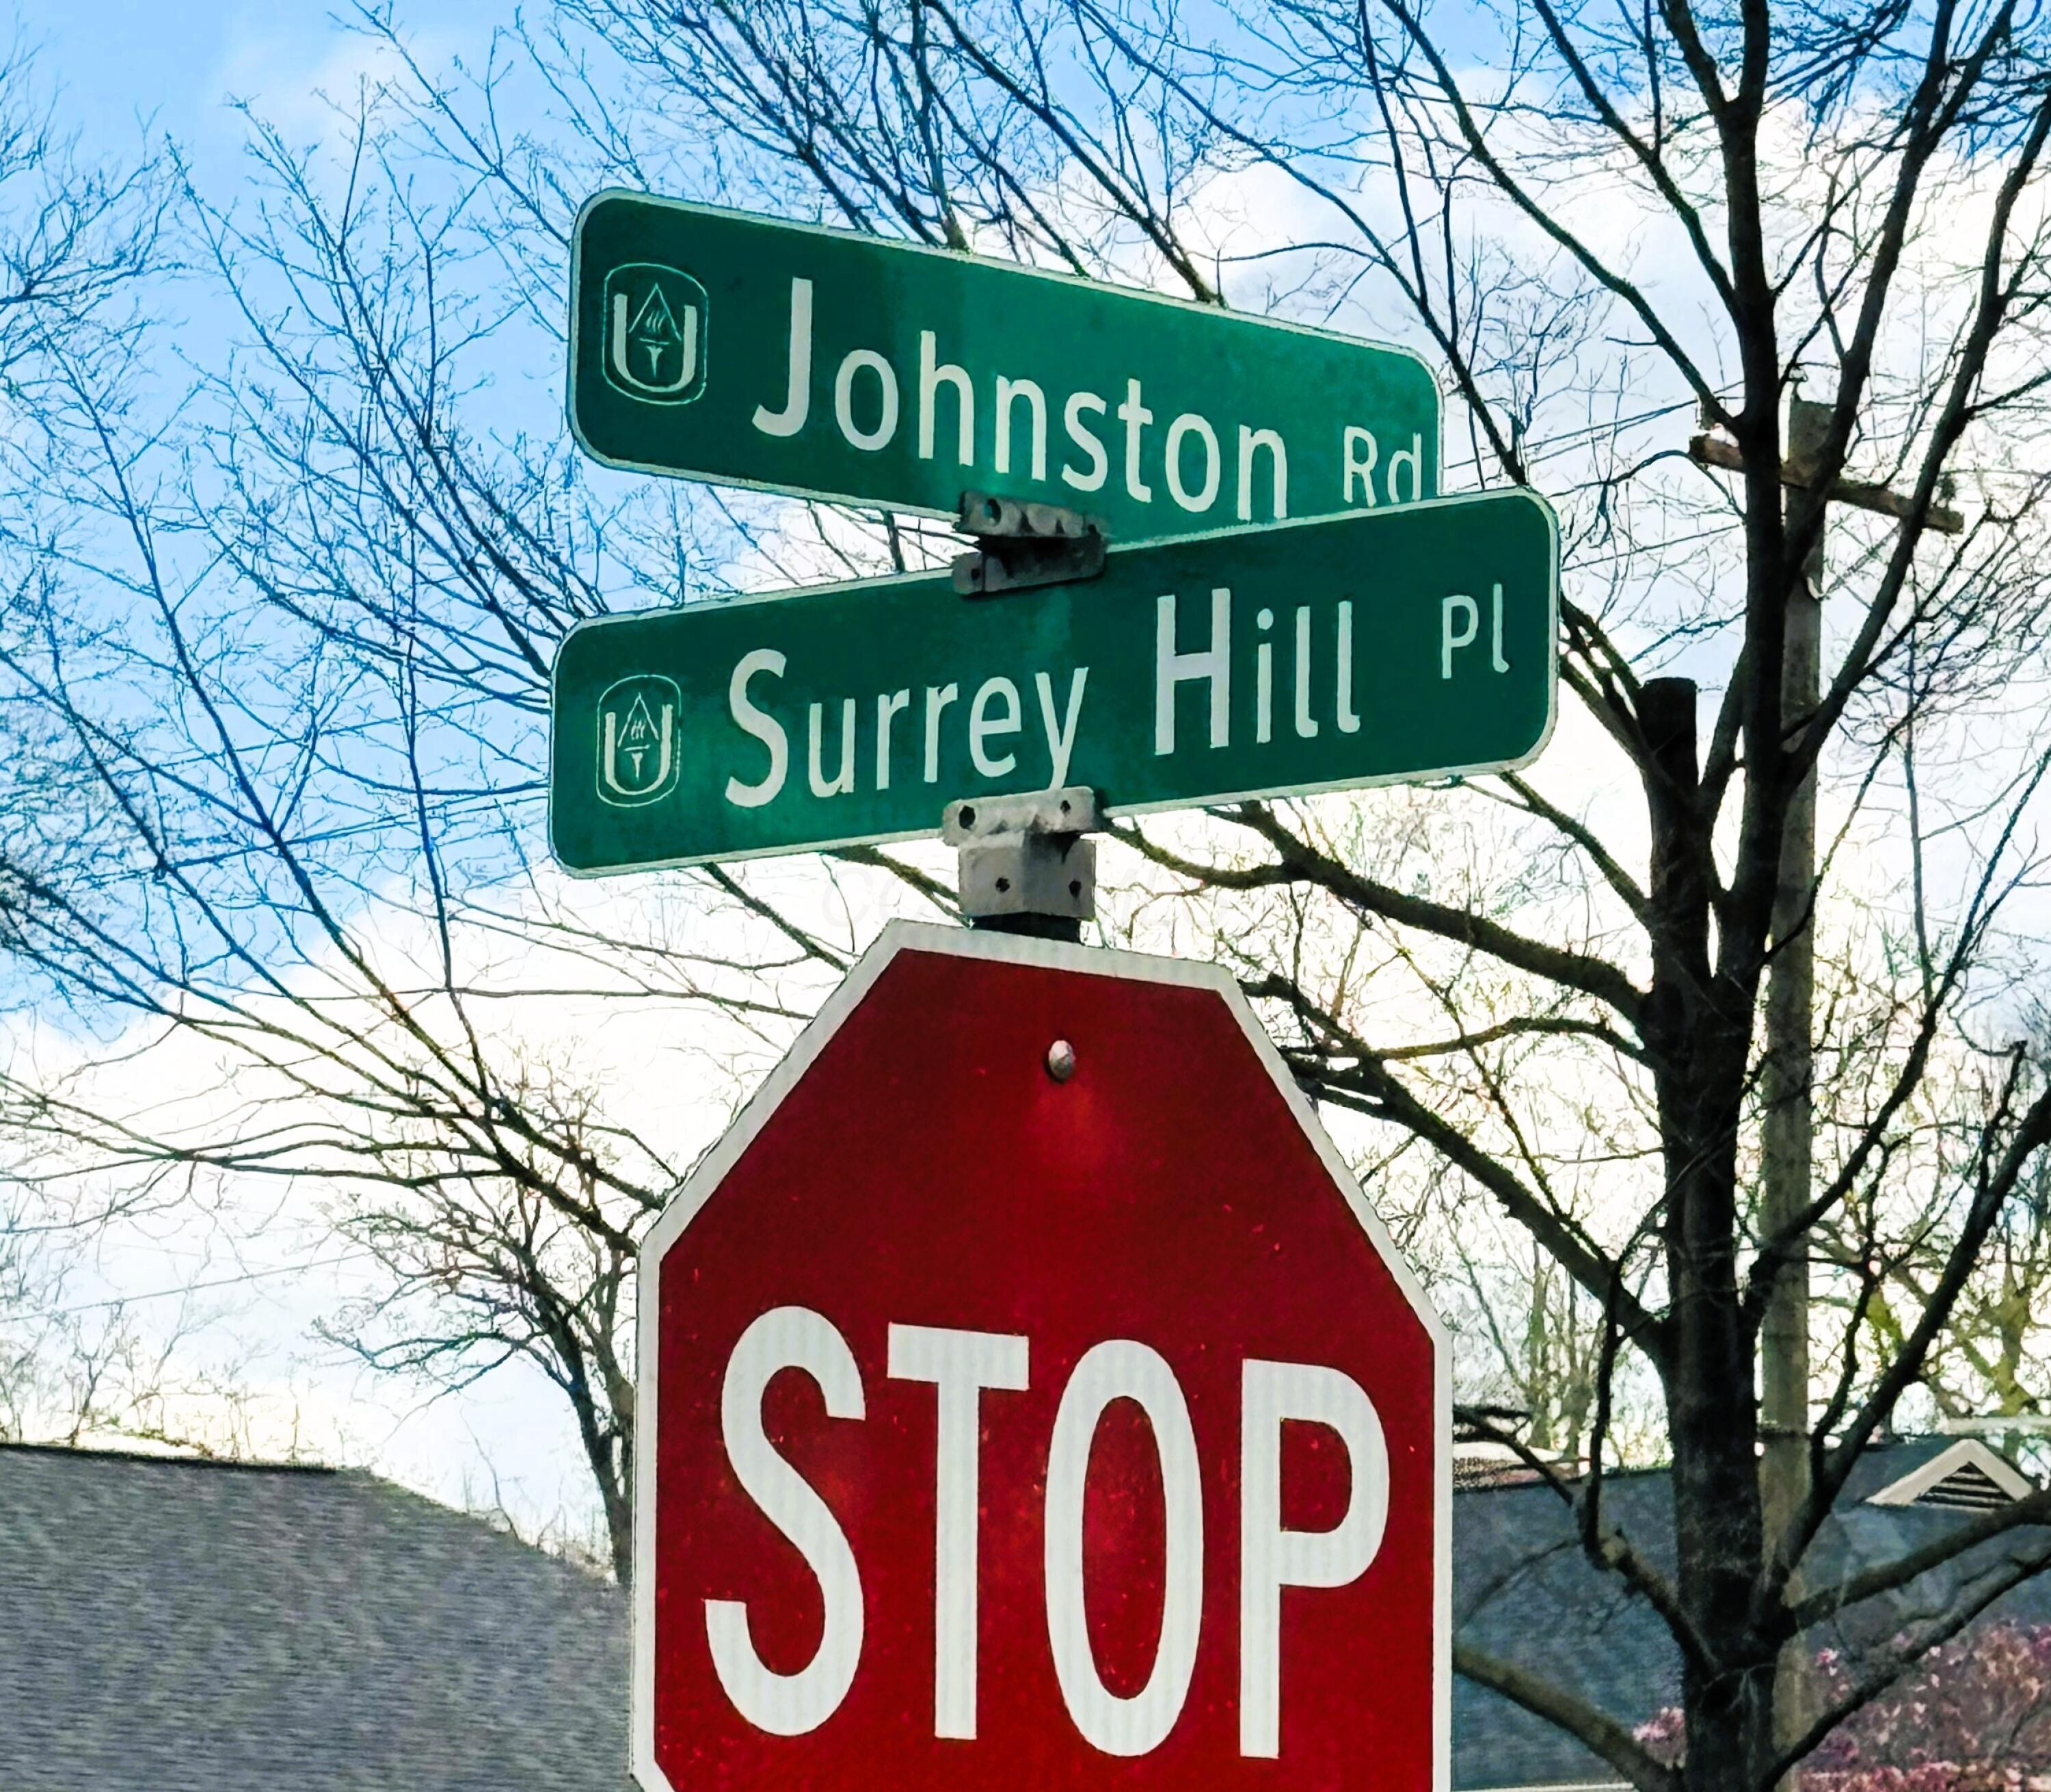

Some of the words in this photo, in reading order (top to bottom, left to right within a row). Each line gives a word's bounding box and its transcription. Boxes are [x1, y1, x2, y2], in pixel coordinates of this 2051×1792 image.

[752, 277, 1288, 520] Johnston
[1343, 425, 1422, 508] Rd
[725, 648, 1089, 808] Surrey
[1155, 587, 1360, 755] Hill
[1441, 583, 1510, 680] Pl
[705, 1305, 1391, 1760] STOP
